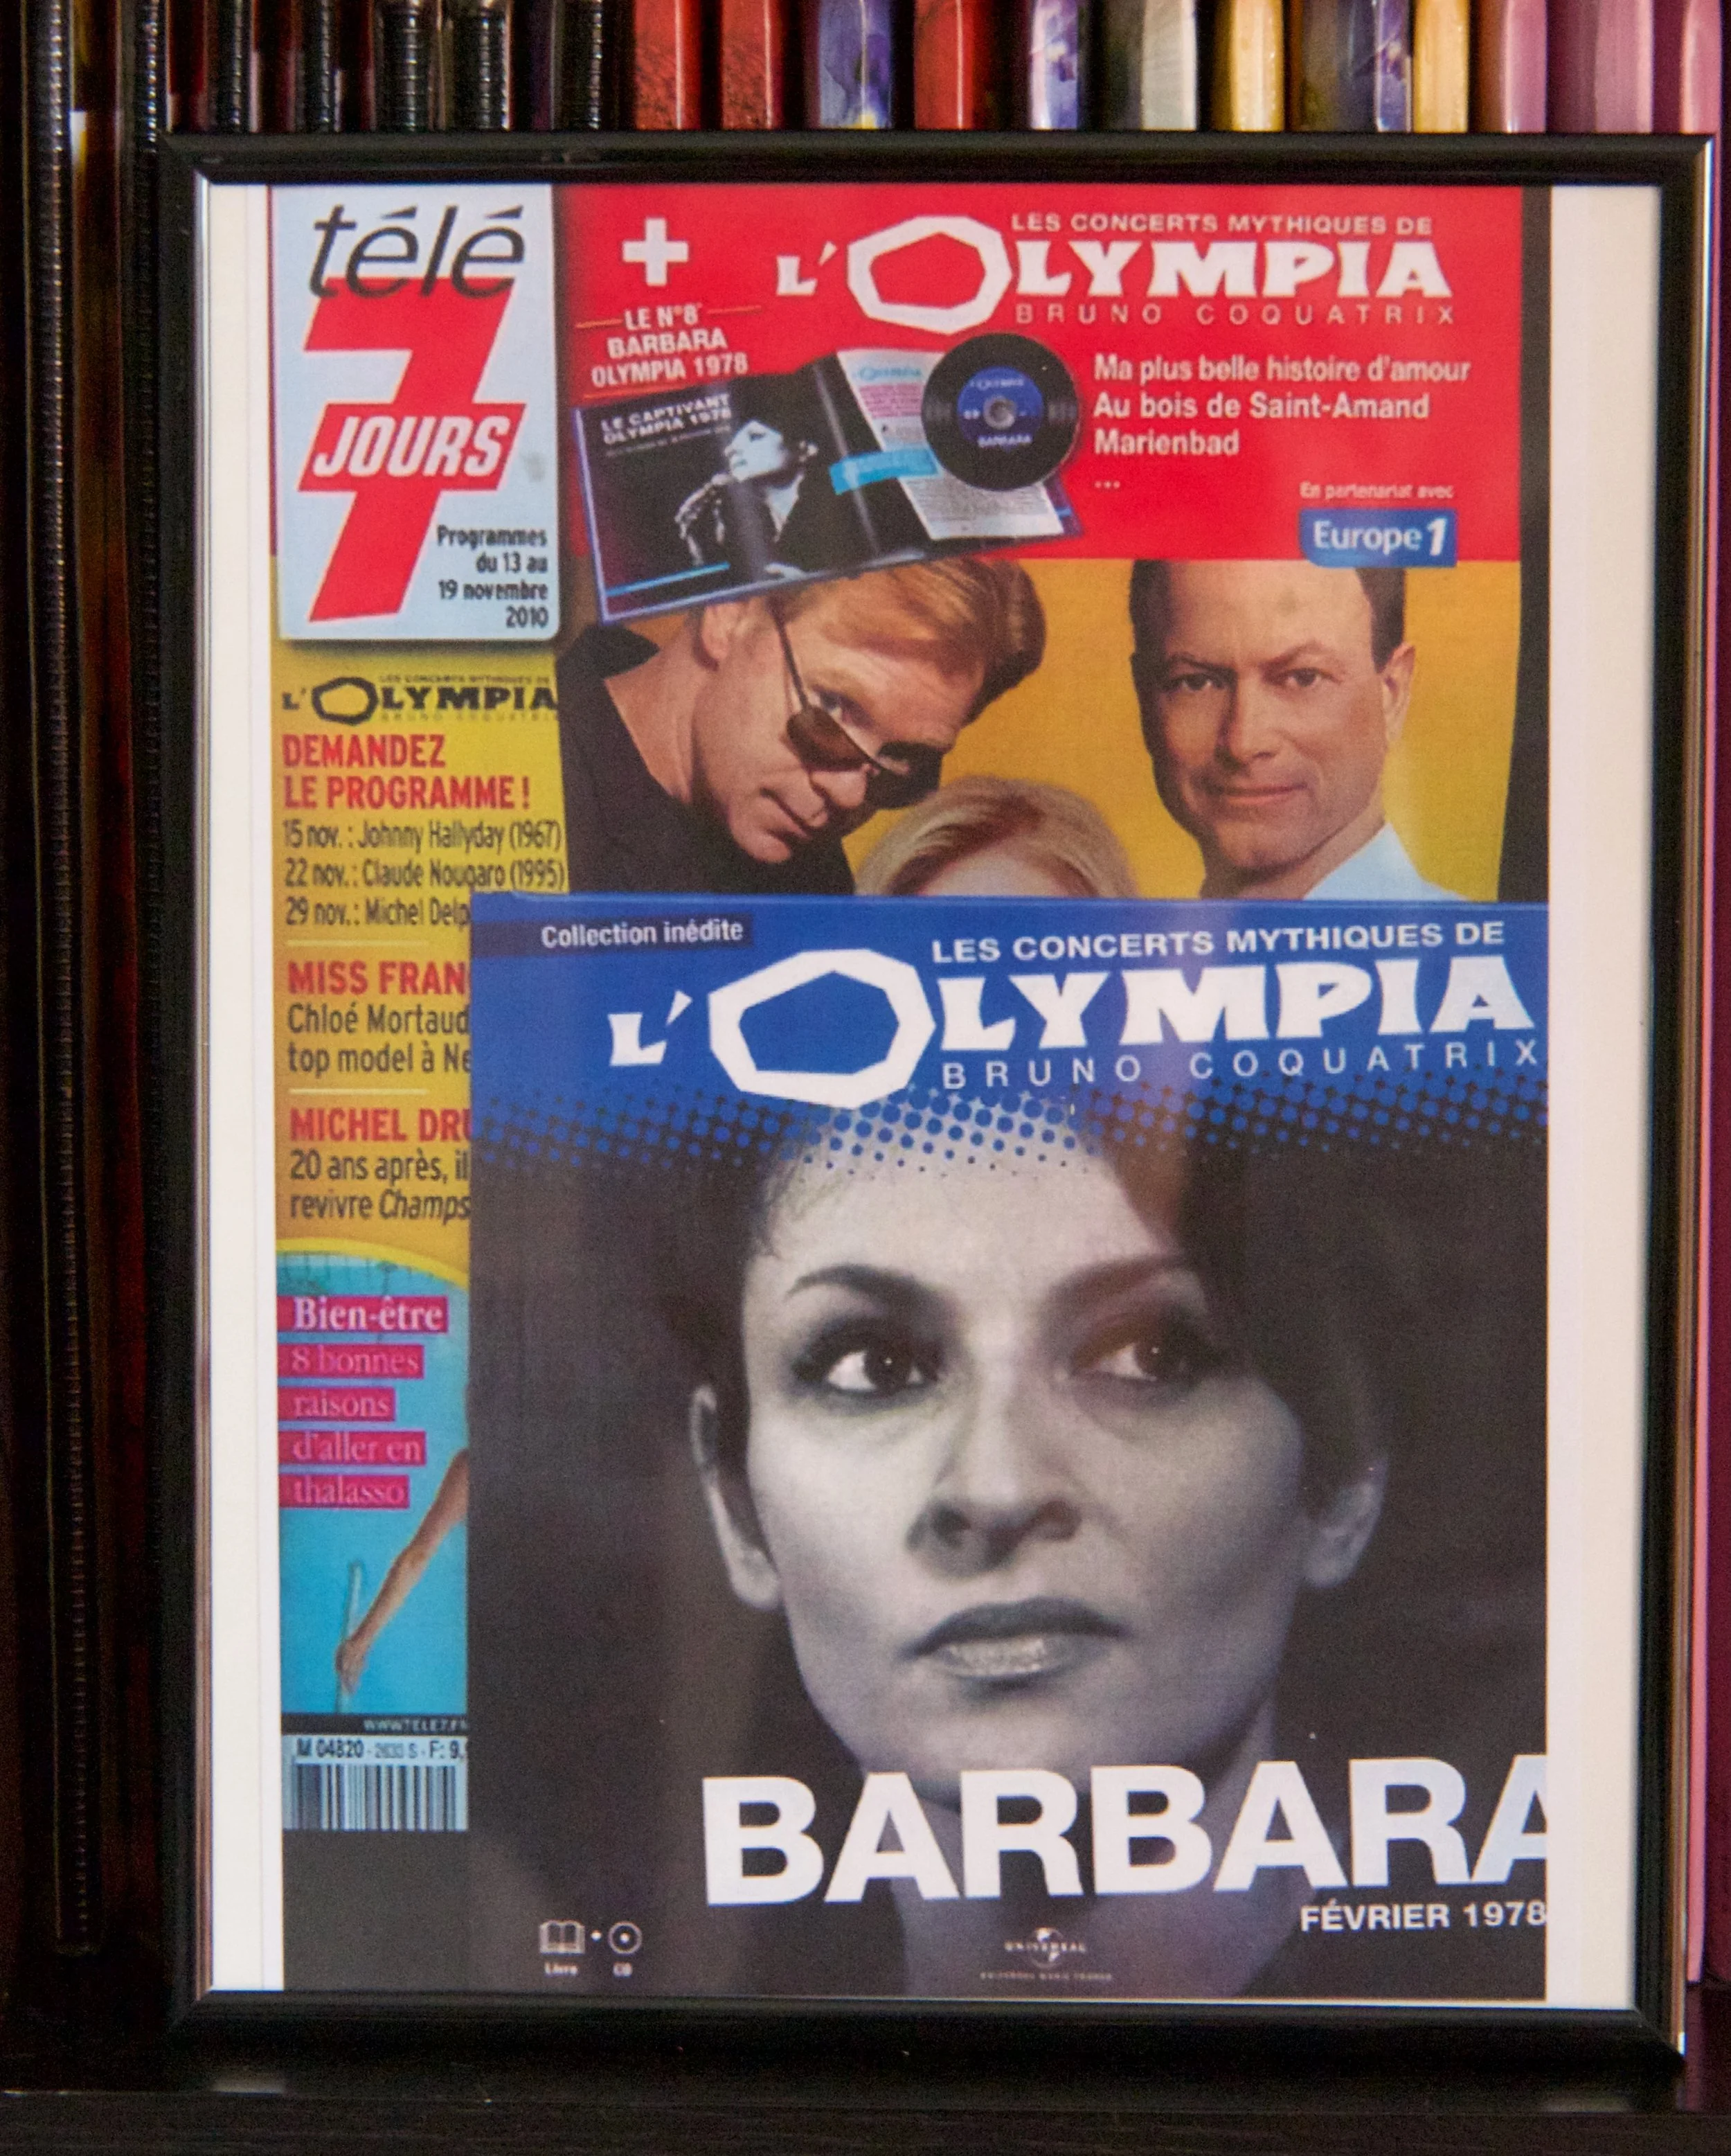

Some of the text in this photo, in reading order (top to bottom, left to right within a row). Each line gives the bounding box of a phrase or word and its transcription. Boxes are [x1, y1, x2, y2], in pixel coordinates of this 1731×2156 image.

[1012, 213, 1433, 235] LES CONCERTS MYTHIQUES DE
[308, 205, 526, 299] télé
[776, 215, 1453, 336] L'OLYMPIA
[625, 306, 652, 330] LE
[1015, 303, 1453, 326] BRUNO COQUATRIX
[607, 327, 728, 359] BARBARA
[592, 352, 749, 388] OLYMPIA 1978
[1094, 353, 1472, 387] Ma plus belle histoire d'amour
[1093, 391, 1430, 418] Au bois de Saint-Amand
[313, 416, 510, 477] JOURS
[1094, 427, 1239, 456] Marienbad
[437, 524, 548, 551] Programmes
[1313, 517, 1449, 557] Europe 1
[476, 551, 548, 574] du 13 au
[438, 579, 548, 600] 19 novembre
[506, 604, 549, 629] 2010
[282, 734, 446, 768] DEMANDEZ
[282, 776, 317, 809] LE
[282, 819, 303, 847] 15
[357, 820, 422, 853] Johnny
[429, 820, 504, 855] Hallyday
[510, 819, 562, 853] (1967)
[285, 857, 307, 888] 22
[363, 859, 424, 888] Claude
[429, 858, 506, 890] Nougaro
[286, 896, 309, 925] 29
[365, 898, 424, 925] Michel
[541, 918, 744, 948] Collection inédite
[932, 920, 1505, 963] LES CONCERTS MYTHIQUES DE
[288, 960, 466, 996] MISS FRAN
[287, 999, 470, 1035] Chloé Mortaud
[607, 947, 1535, 1109] L'OLYMPIA
[288, 1040, 331, 1079] top
[338, 1042, 414, 1074] model
[420, 1040, 436, 1073] à
[942, 1039, 1539, 1089] BRUNO COQUATRIX
[289, 1108, 409, 1143] MICHEL
[289, 1148, 322, 1181] 20
[328, 1155, 369, 1182] ans
[374, 1147, 449, 1186] après,
[290, 1187, 472, 1227] revivre Champs
[294, 1295, 444, 1331] Bien-être
[292, 1345, 420, 1374] 8 bonnes
[294, 1389, 391, 1418] raisons
[292, 1429, 422, 1462] d'aller en
[293, 1475, 406, 1504] thalasso
[702, 1754, 1548, 1906] BARBARA
[1300, 1898, 1547, 1932] FÉVRIER 1978
